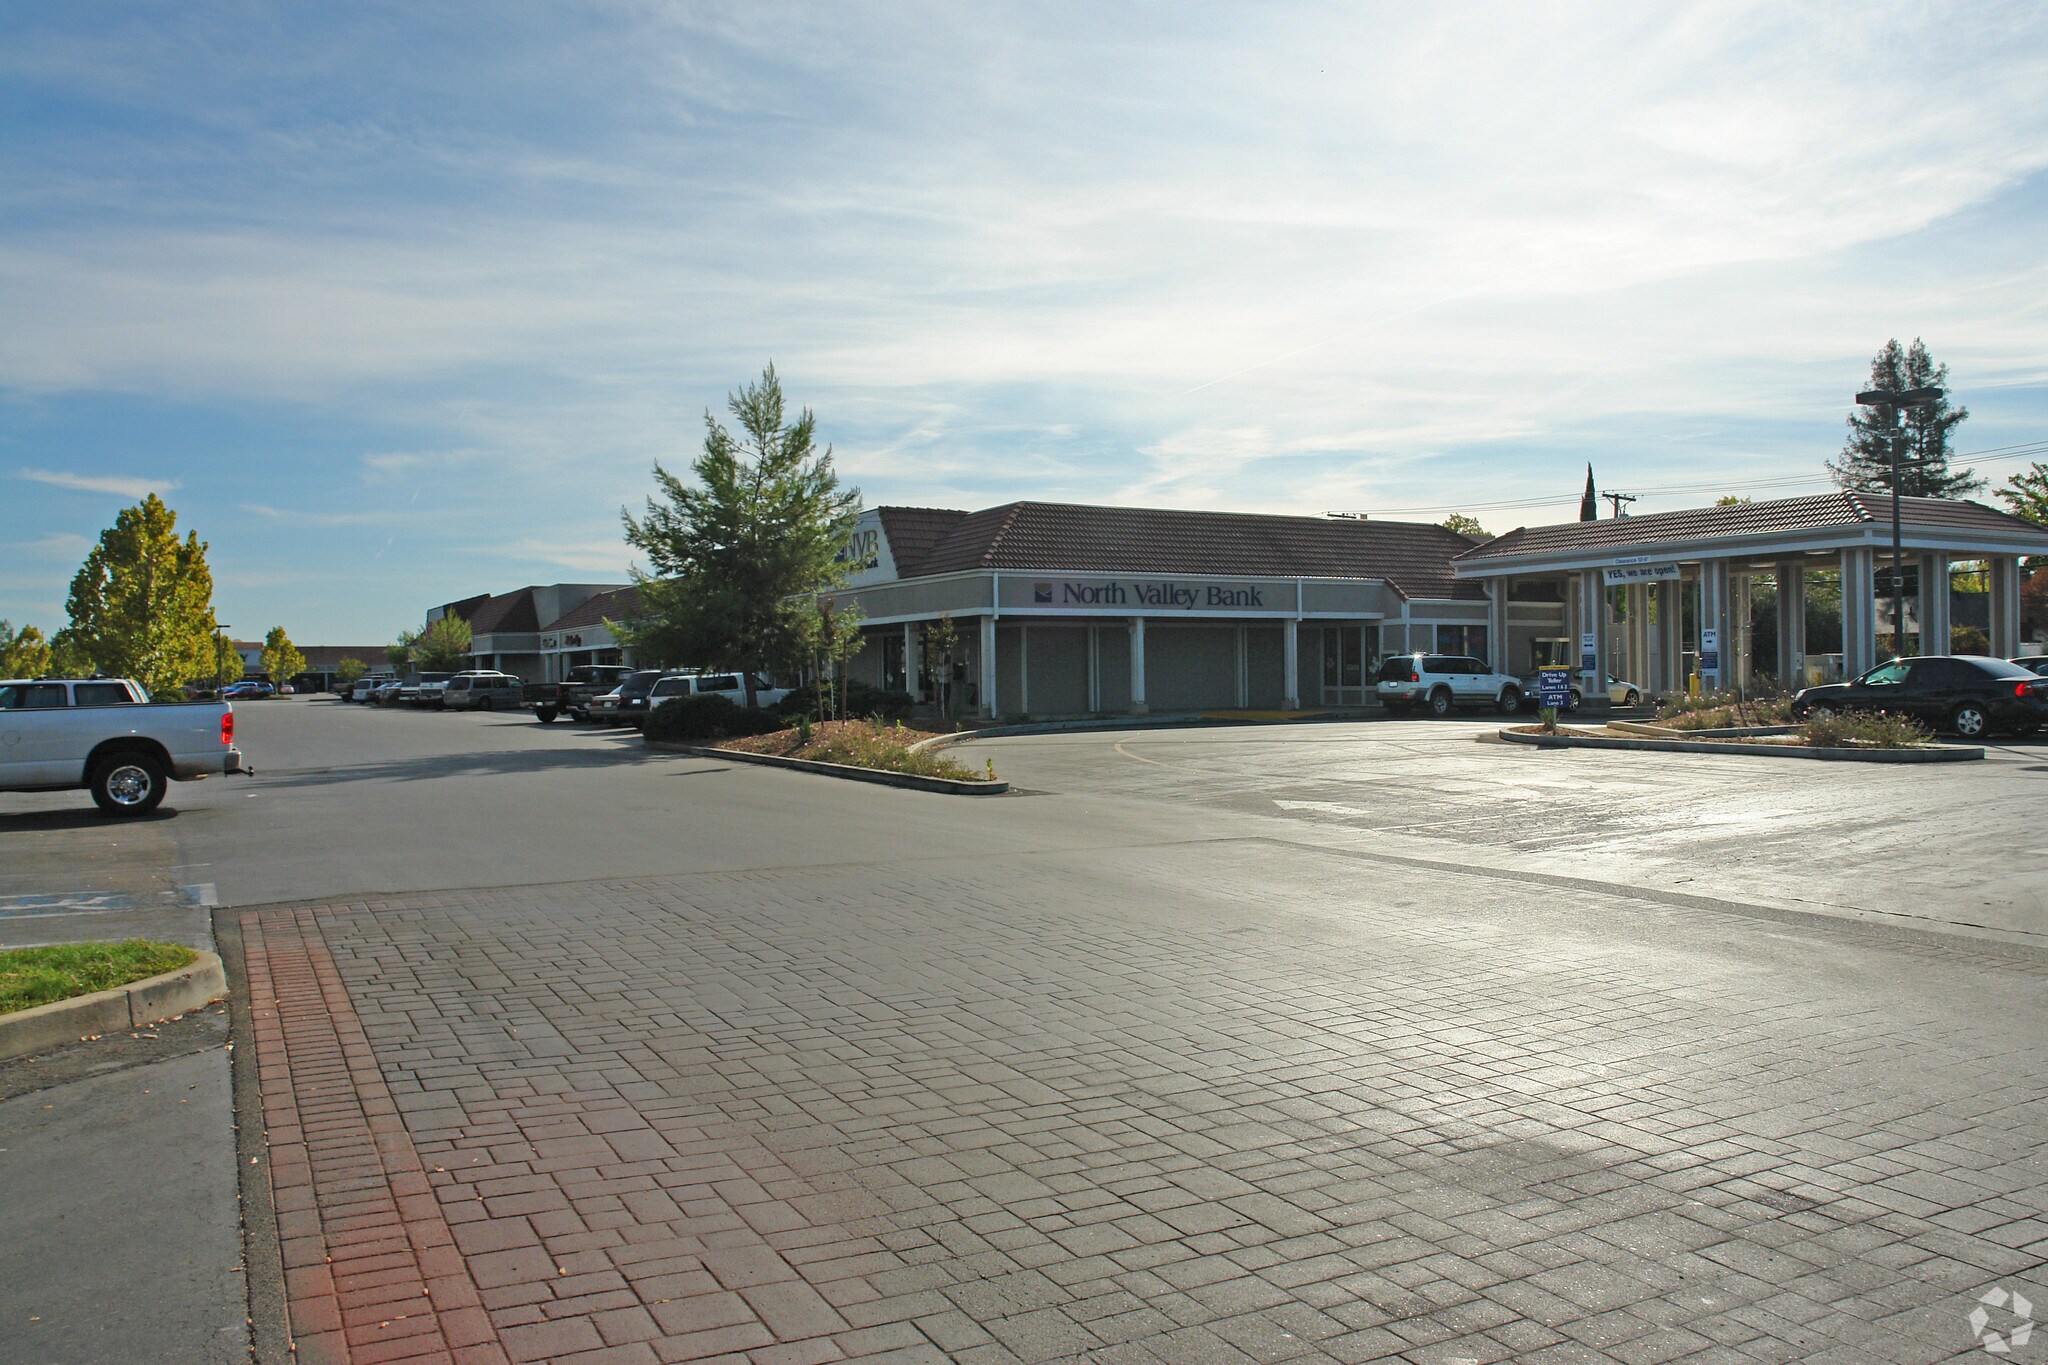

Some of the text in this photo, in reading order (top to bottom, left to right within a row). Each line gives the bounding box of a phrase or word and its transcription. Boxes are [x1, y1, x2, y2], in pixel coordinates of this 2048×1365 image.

[1607, 569, 1625, 579] YES,
[1640, 568, 1652, 576] are
[1654, 564, 1676, 576] open!
[1063, 582, 1263, 610] North Valley Bank
